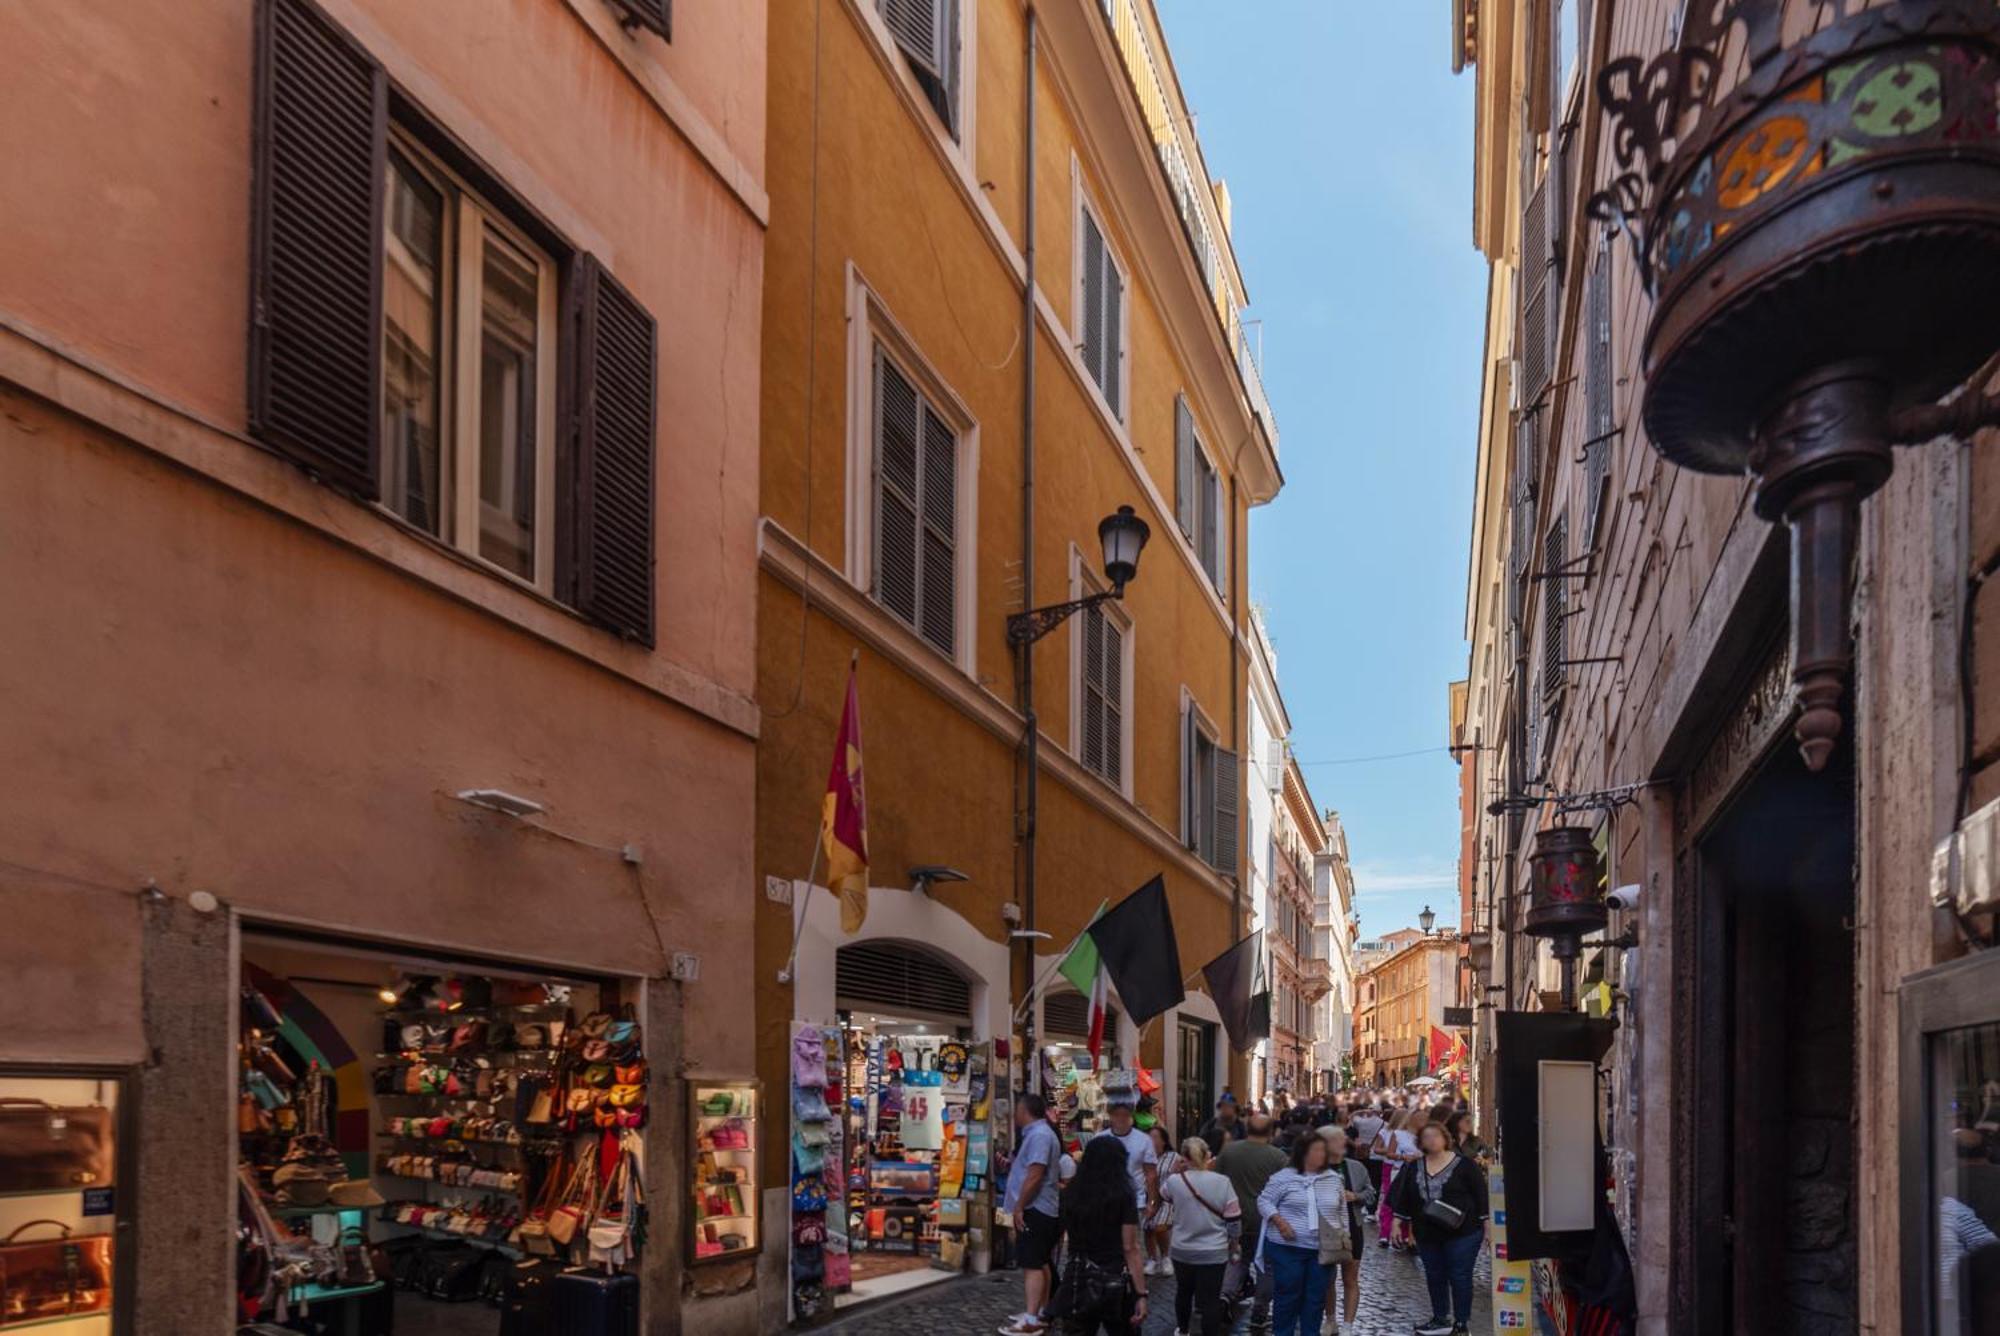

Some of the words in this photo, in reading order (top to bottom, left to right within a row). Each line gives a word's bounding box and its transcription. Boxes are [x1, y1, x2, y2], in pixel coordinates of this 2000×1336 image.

[676, 956, 696, 976] 87
[868, 1049, 880, 1096] ITALIA
[908, 1097, 928, 1120] 45
